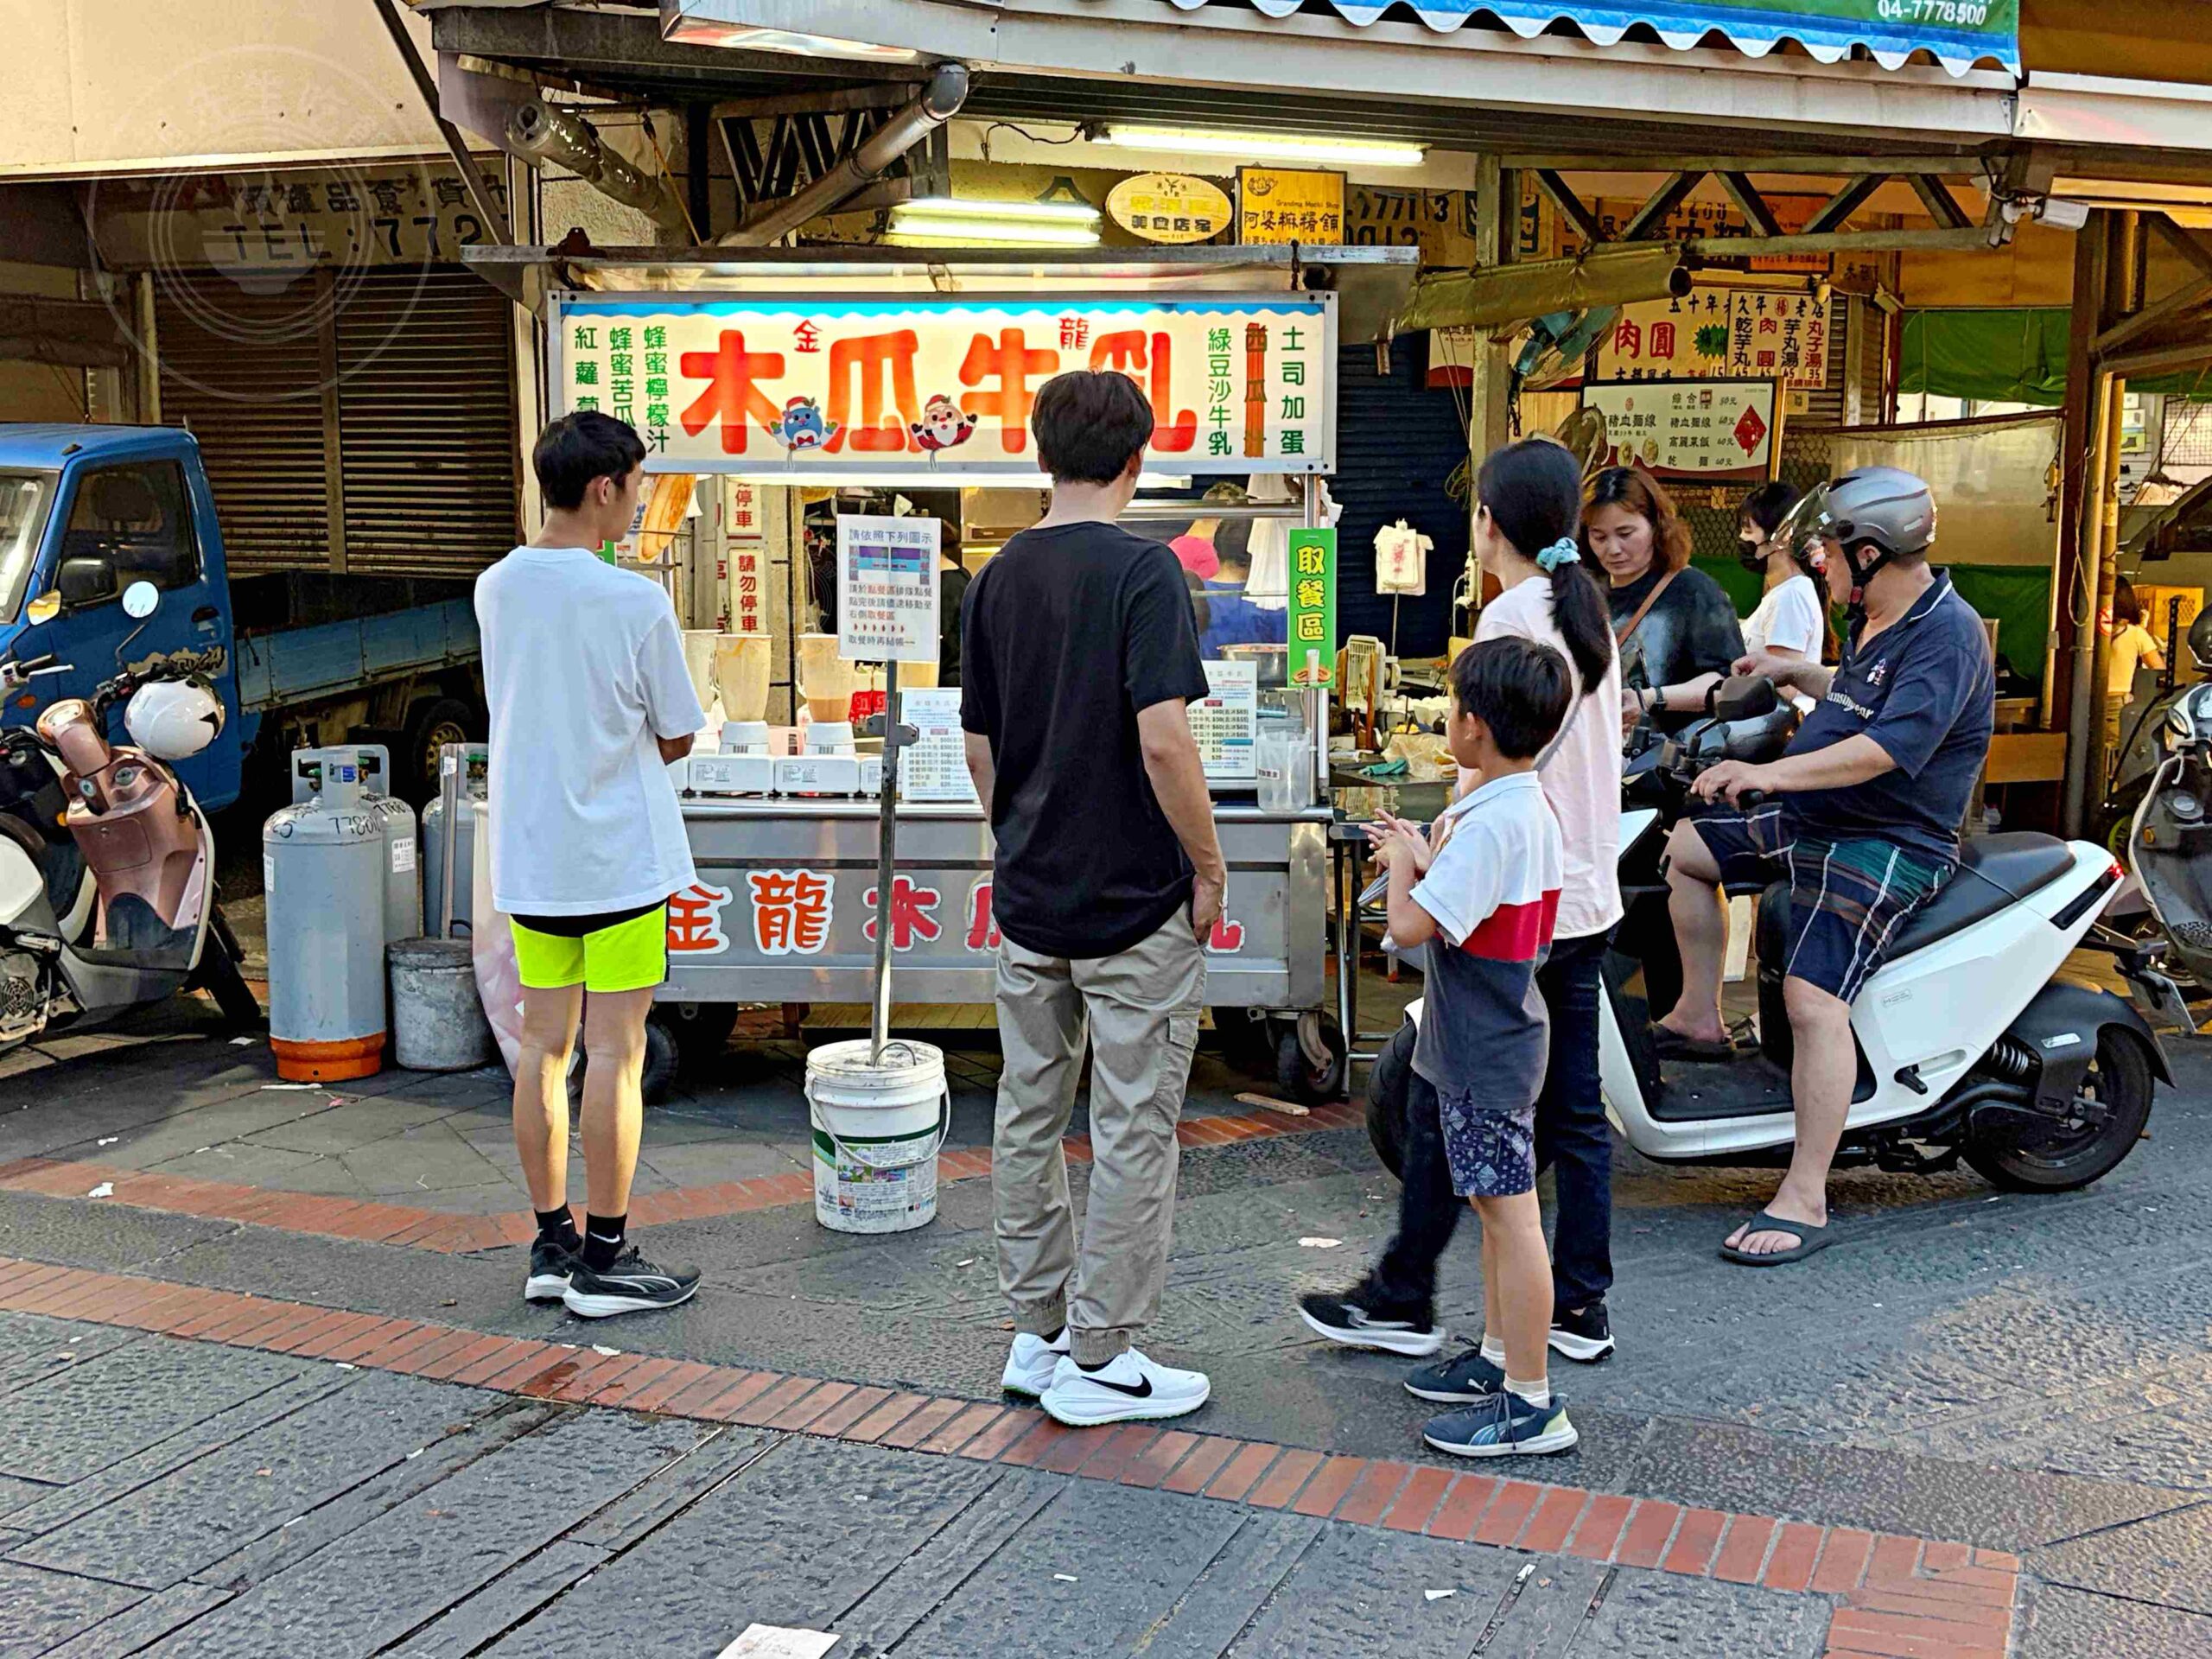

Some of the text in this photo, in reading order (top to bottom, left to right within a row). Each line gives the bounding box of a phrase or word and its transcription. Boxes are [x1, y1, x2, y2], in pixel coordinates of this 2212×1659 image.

[1878, 0, 1987, 26] 04-7778500
[1131, 214, 1211, 232] 美食店家
[792, 317, 1089, 353] 金 龍
[1614, 319, 1676, 359] 肉圓
[1734, 316, 1754, 367] 乾芋丸
[1758, 317, 1777, 367] 肉圓
[1781, 319, 1802, 368] 芋丸湯
[1804, 320, 1825, 369] 丸子湯
[644, 325, 670, 454] 蜂蜜檸檬汁
[1208, 327, 1232, 455] 綠豆沙牛乳
[1281, 327, 1306, 455] 土司加蛋
[739, 555, 759, 632] 請勿停車
[1297, 545, 1325, 641] 取餐區
